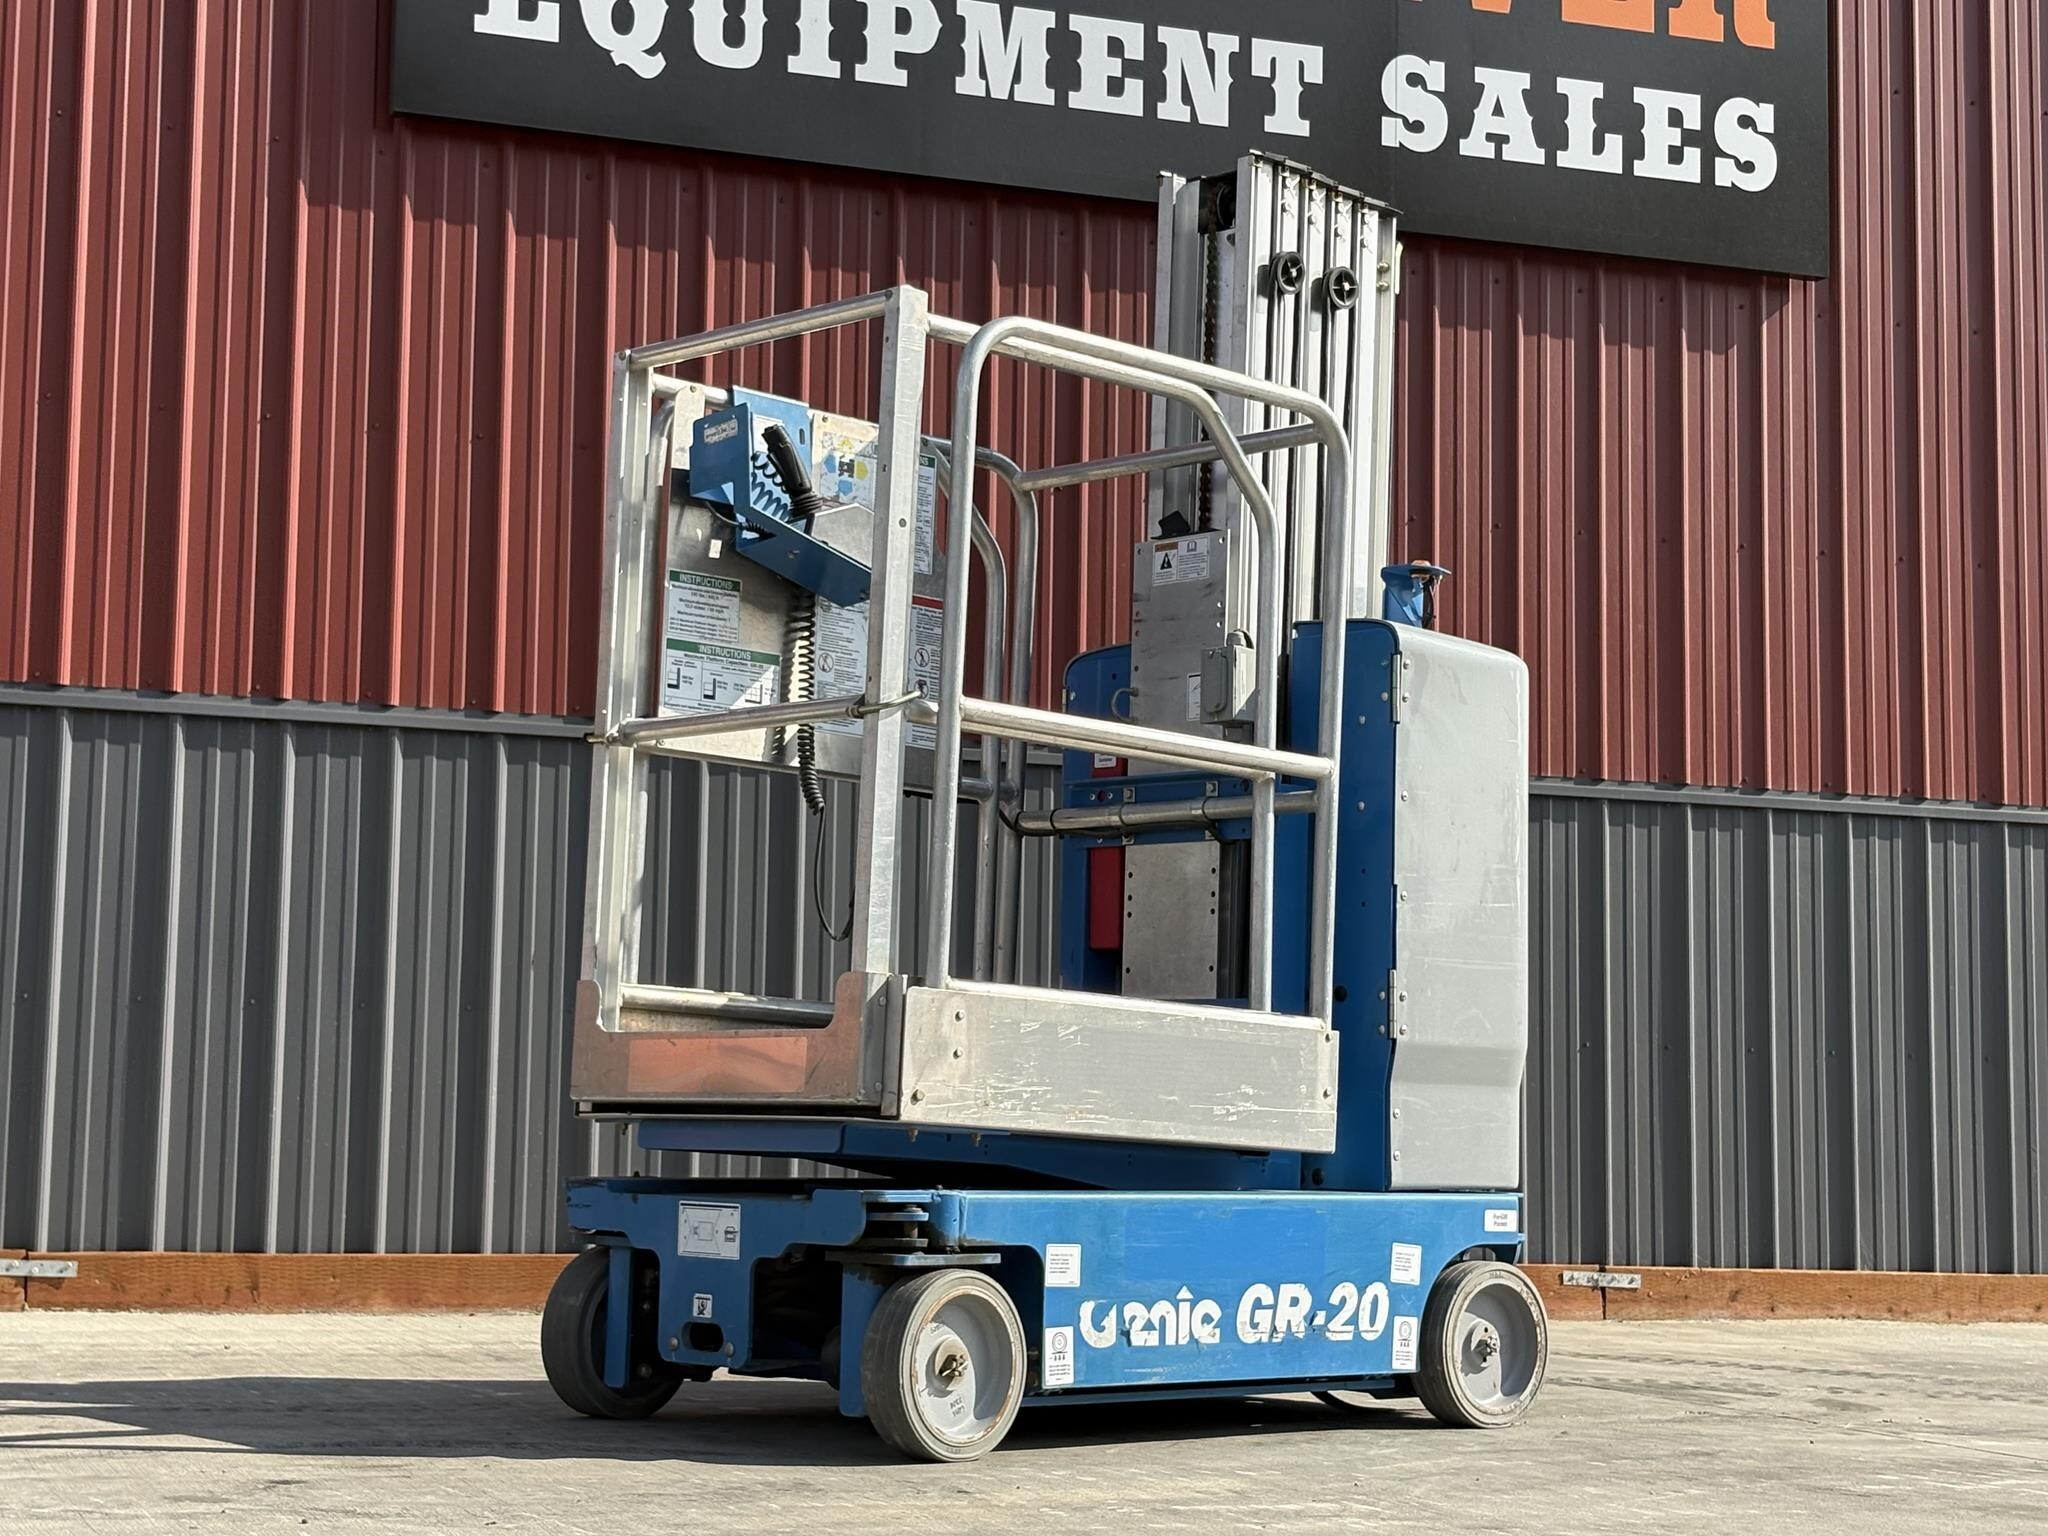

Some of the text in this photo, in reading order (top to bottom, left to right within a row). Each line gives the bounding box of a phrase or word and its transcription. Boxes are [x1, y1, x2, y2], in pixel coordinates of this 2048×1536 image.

[1381, 54, 1778, 192] SALES
[680, 573, 734, 590] INSTRUCTIONS
[699, 644, 752, 660] INSTRUCTIONS
[1236, 1281, 1389, 1344] GR-20
